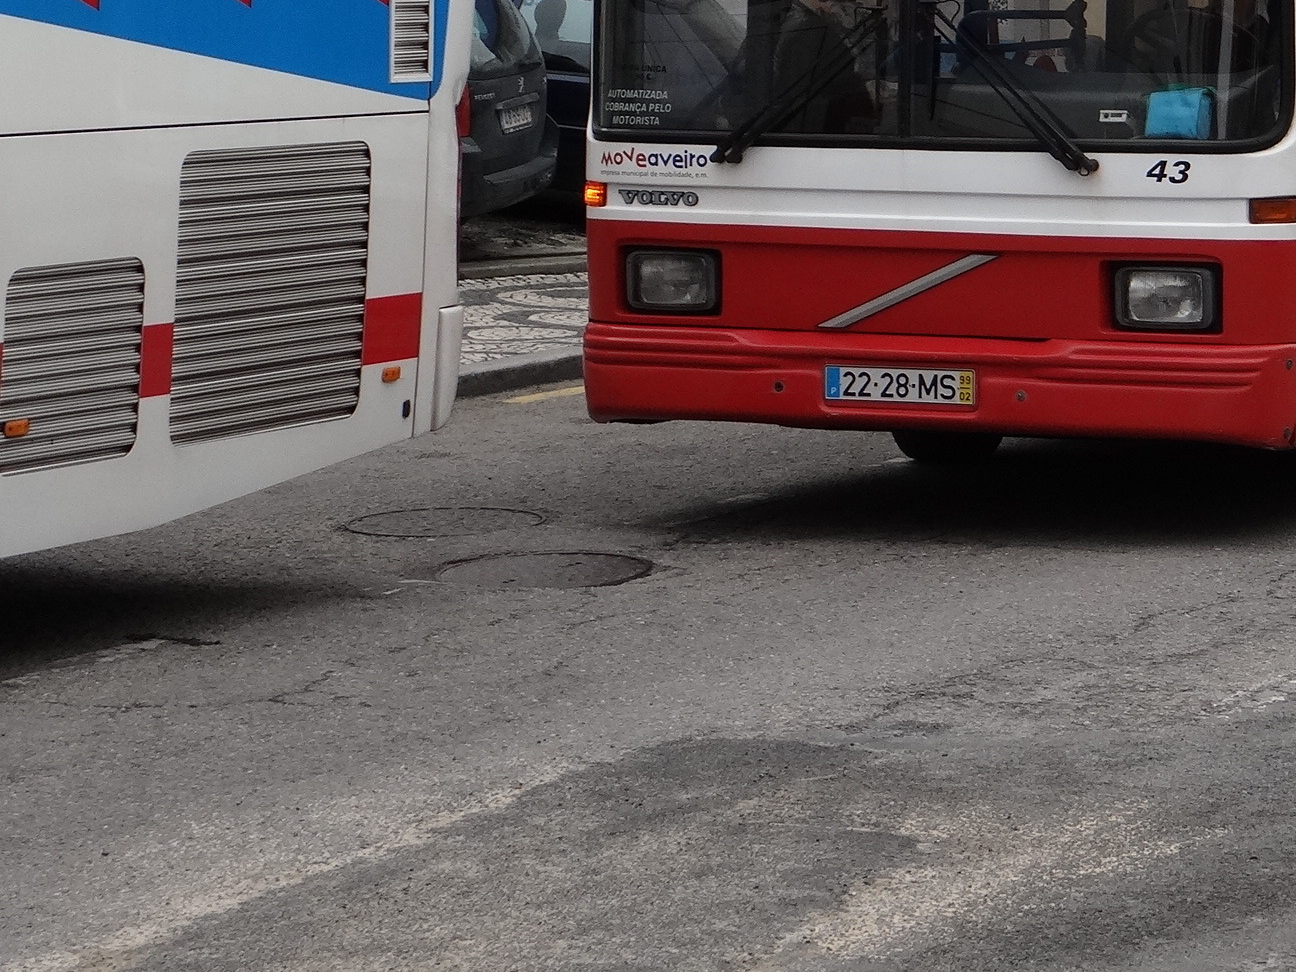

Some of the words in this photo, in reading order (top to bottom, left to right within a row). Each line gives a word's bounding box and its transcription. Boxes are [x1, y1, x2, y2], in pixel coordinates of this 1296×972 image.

[607, 89, 668, 100] AUTOMATIZADA
[605, 102, 647, 114] COBRANÇA
[648, 103, 672, 113] PELO
[612, 115, 660, 125] MOTORISTA
[621, 169, 649, 178] municipal
[1146, 160, 1191, 184] 43
[618, 189, 699, 207] VOLVO
[830, 387, 837, 395] P
[959, 392, 971, 402] 02
